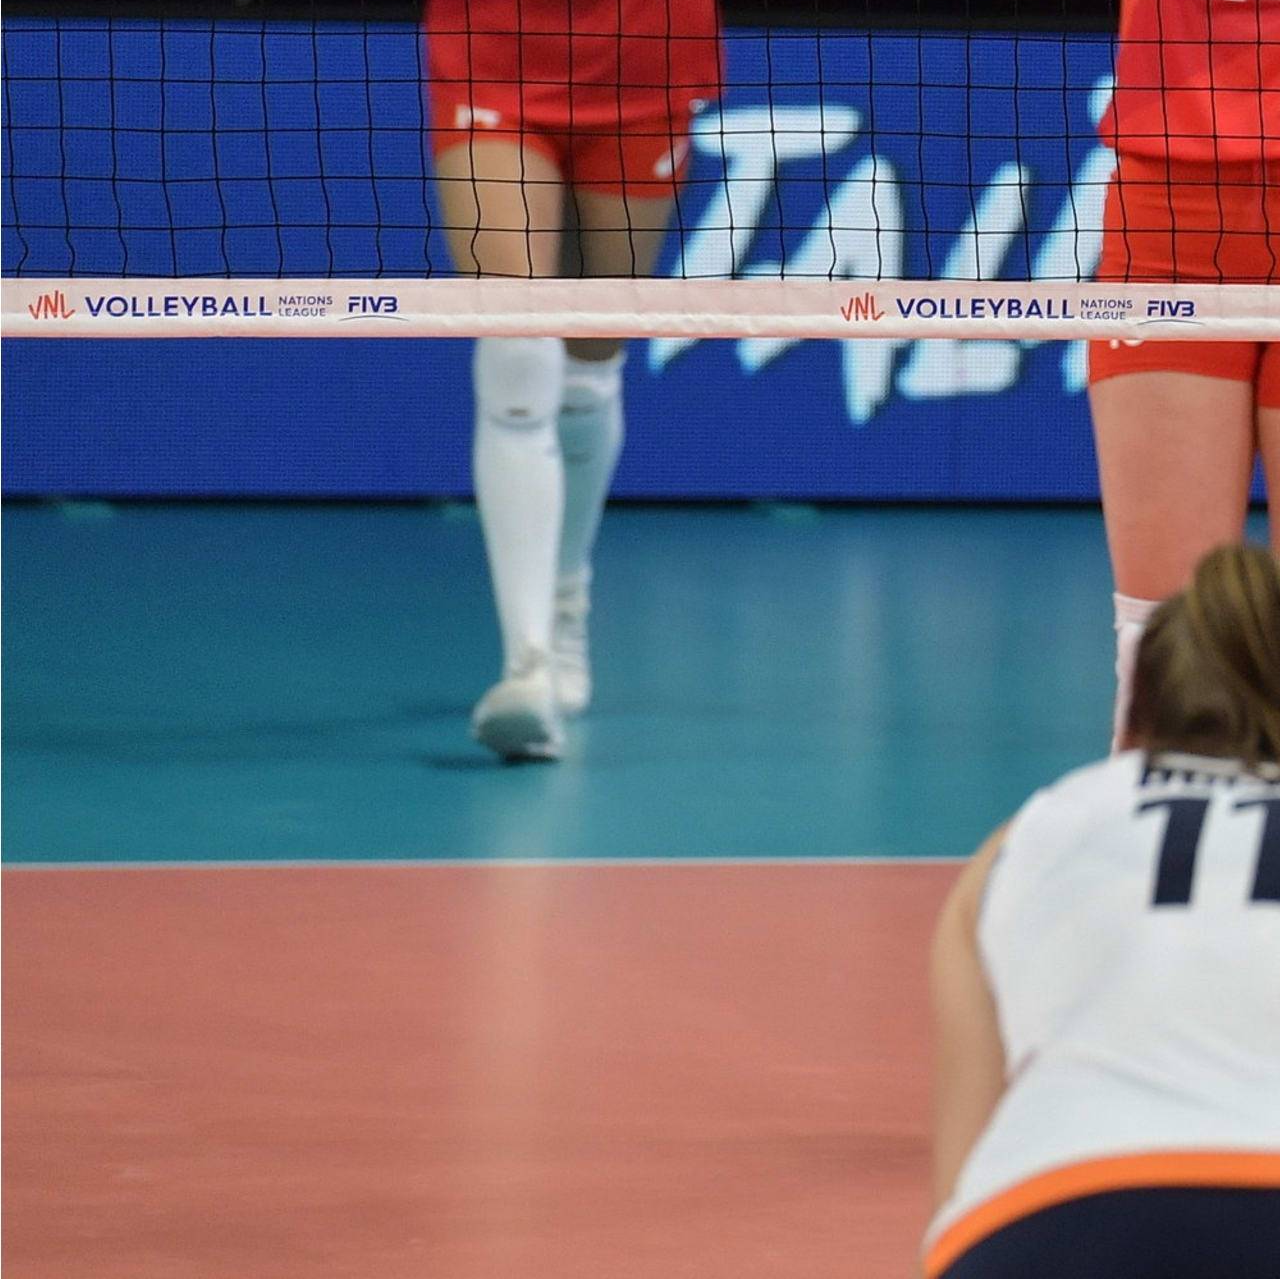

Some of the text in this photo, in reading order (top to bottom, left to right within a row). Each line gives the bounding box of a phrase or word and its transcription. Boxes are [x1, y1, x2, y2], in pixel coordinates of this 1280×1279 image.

[85, 295, 273, 318] VOLLEYBALL
[278, 295, 334, 306] NATIONS
[348, 295, 398, 313] FIVB
[1080, 299, 1134, 310] NATIONS
[278, 307, 326, 317] LEAGUE
[896, 298, 1075, 319] VOLLEYBALL
[1146, 301, 1195, 317] FIVB
[1080, 311, 1127, 320] LEAGUE
